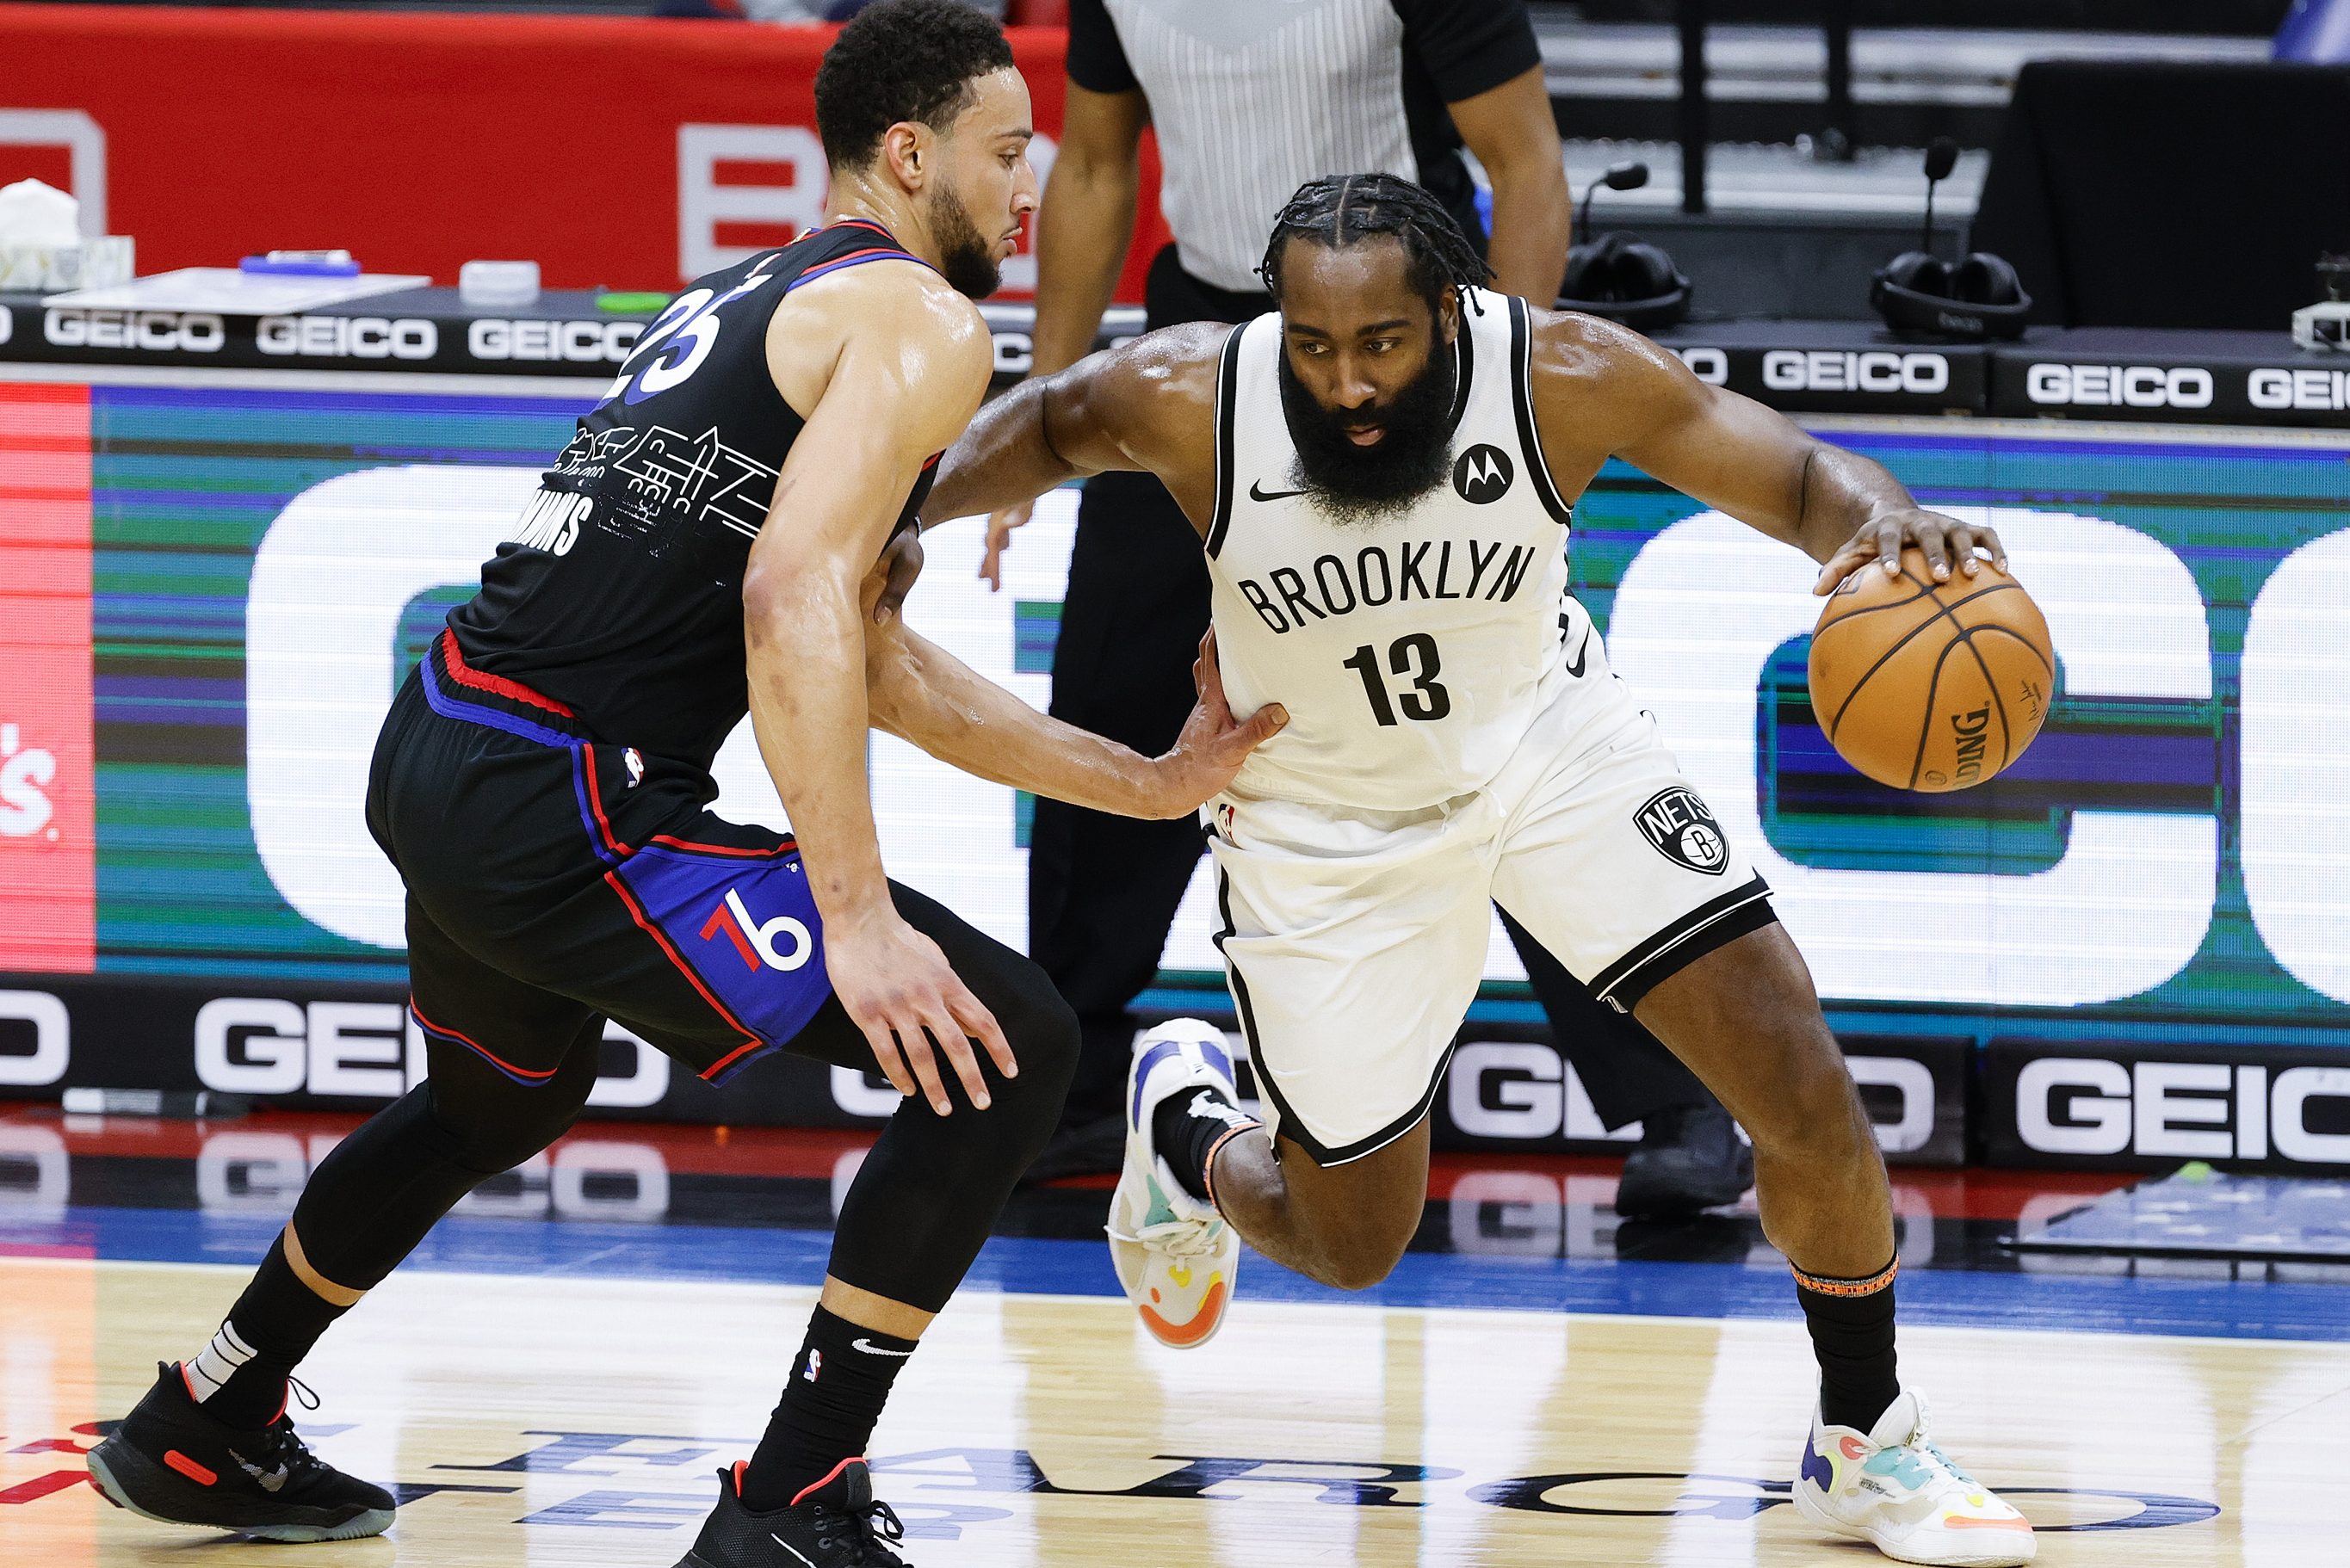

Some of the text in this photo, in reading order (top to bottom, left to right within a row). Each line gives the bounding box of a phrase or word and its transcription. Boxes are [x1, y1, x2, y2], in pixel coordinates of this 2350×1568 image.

[44, 306, 225, 353] GEICO
[256, 315, 438, 360] GEICO
[1762, 350, 1949, 394] GEICO
[2026, 363, 2214, 410] GEICO
[2248, 367, 2350, 411] GEI
[1238, 539, 1536, 634] BROOKLYN
[1343, 633, 1451, 726] 13
[1643, 792, 1714, 845] NETS
[699, 887, 813, 972] 76
